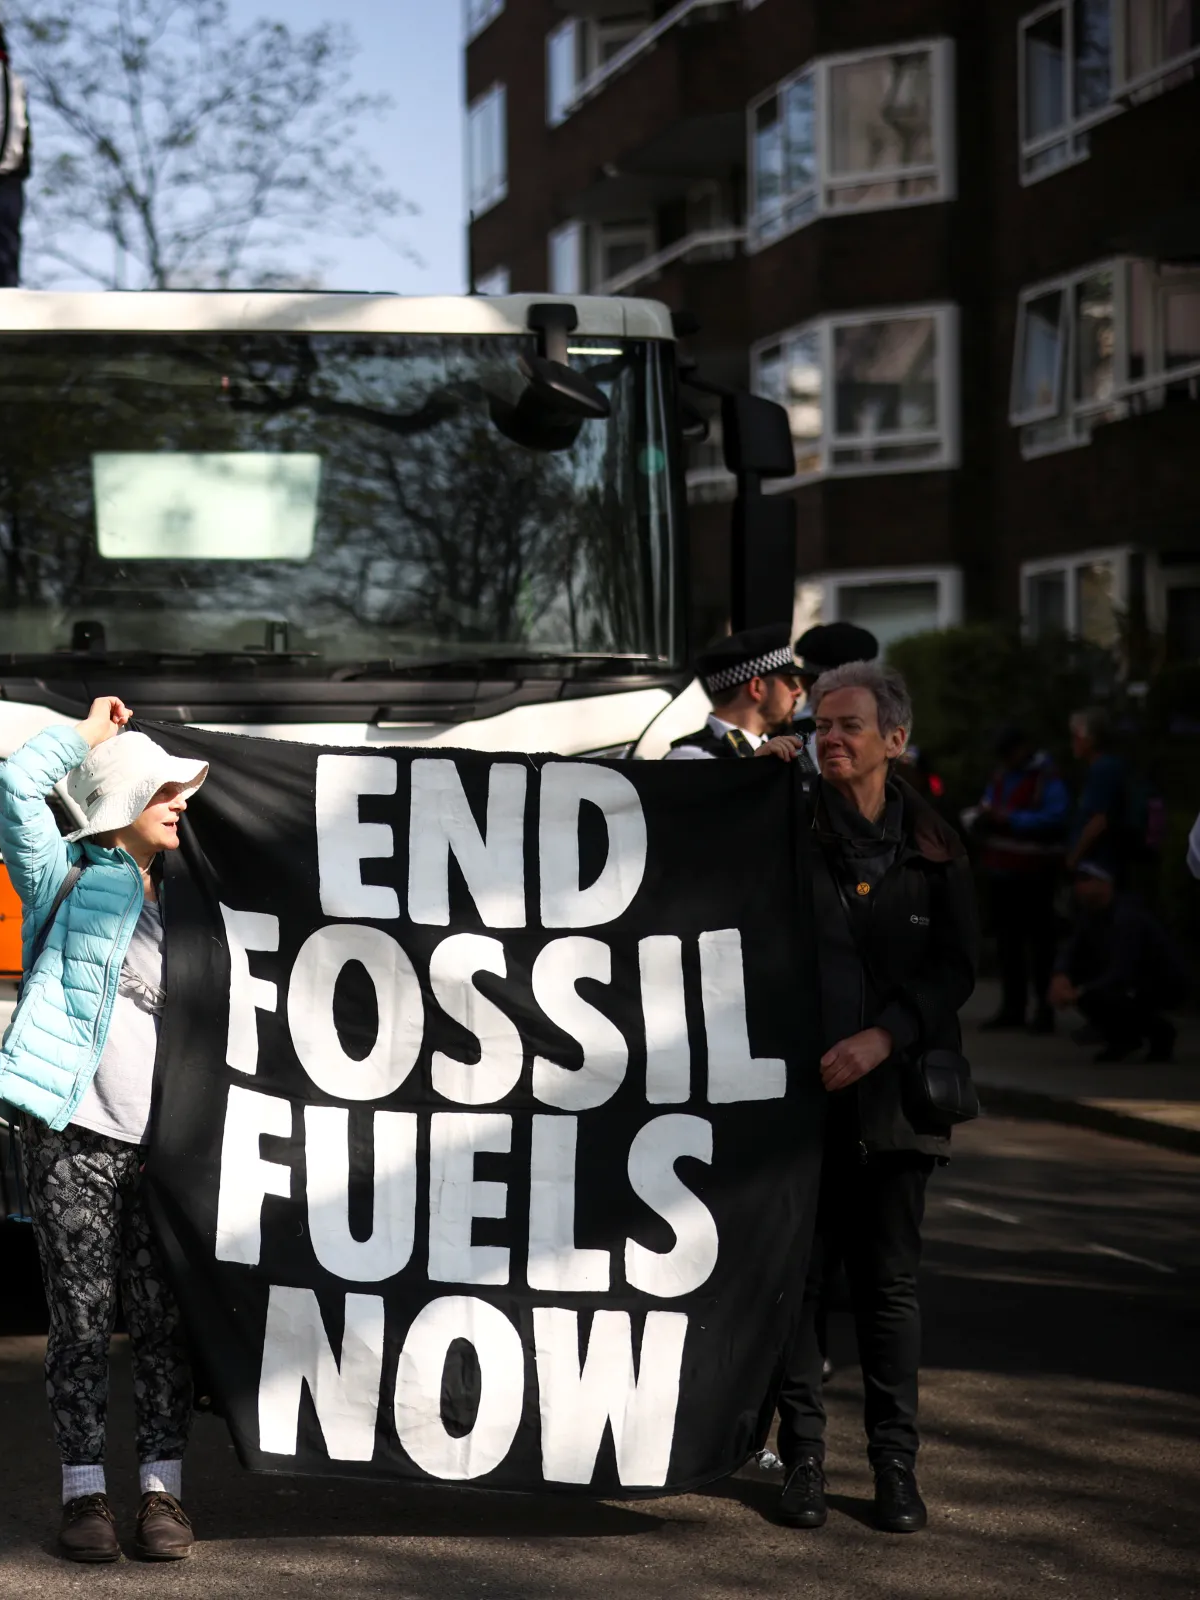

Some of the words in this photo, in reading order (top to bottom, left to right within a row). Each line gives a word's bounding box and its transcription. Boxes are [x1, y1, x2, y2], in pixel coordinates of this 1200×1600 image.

[315, 754, 648, 929] END
[219, 901, 787, 1111] FOSSIL
[215, 1084, 718, 1298] FUELS
[258, 1285, 689, 1486] NOW
